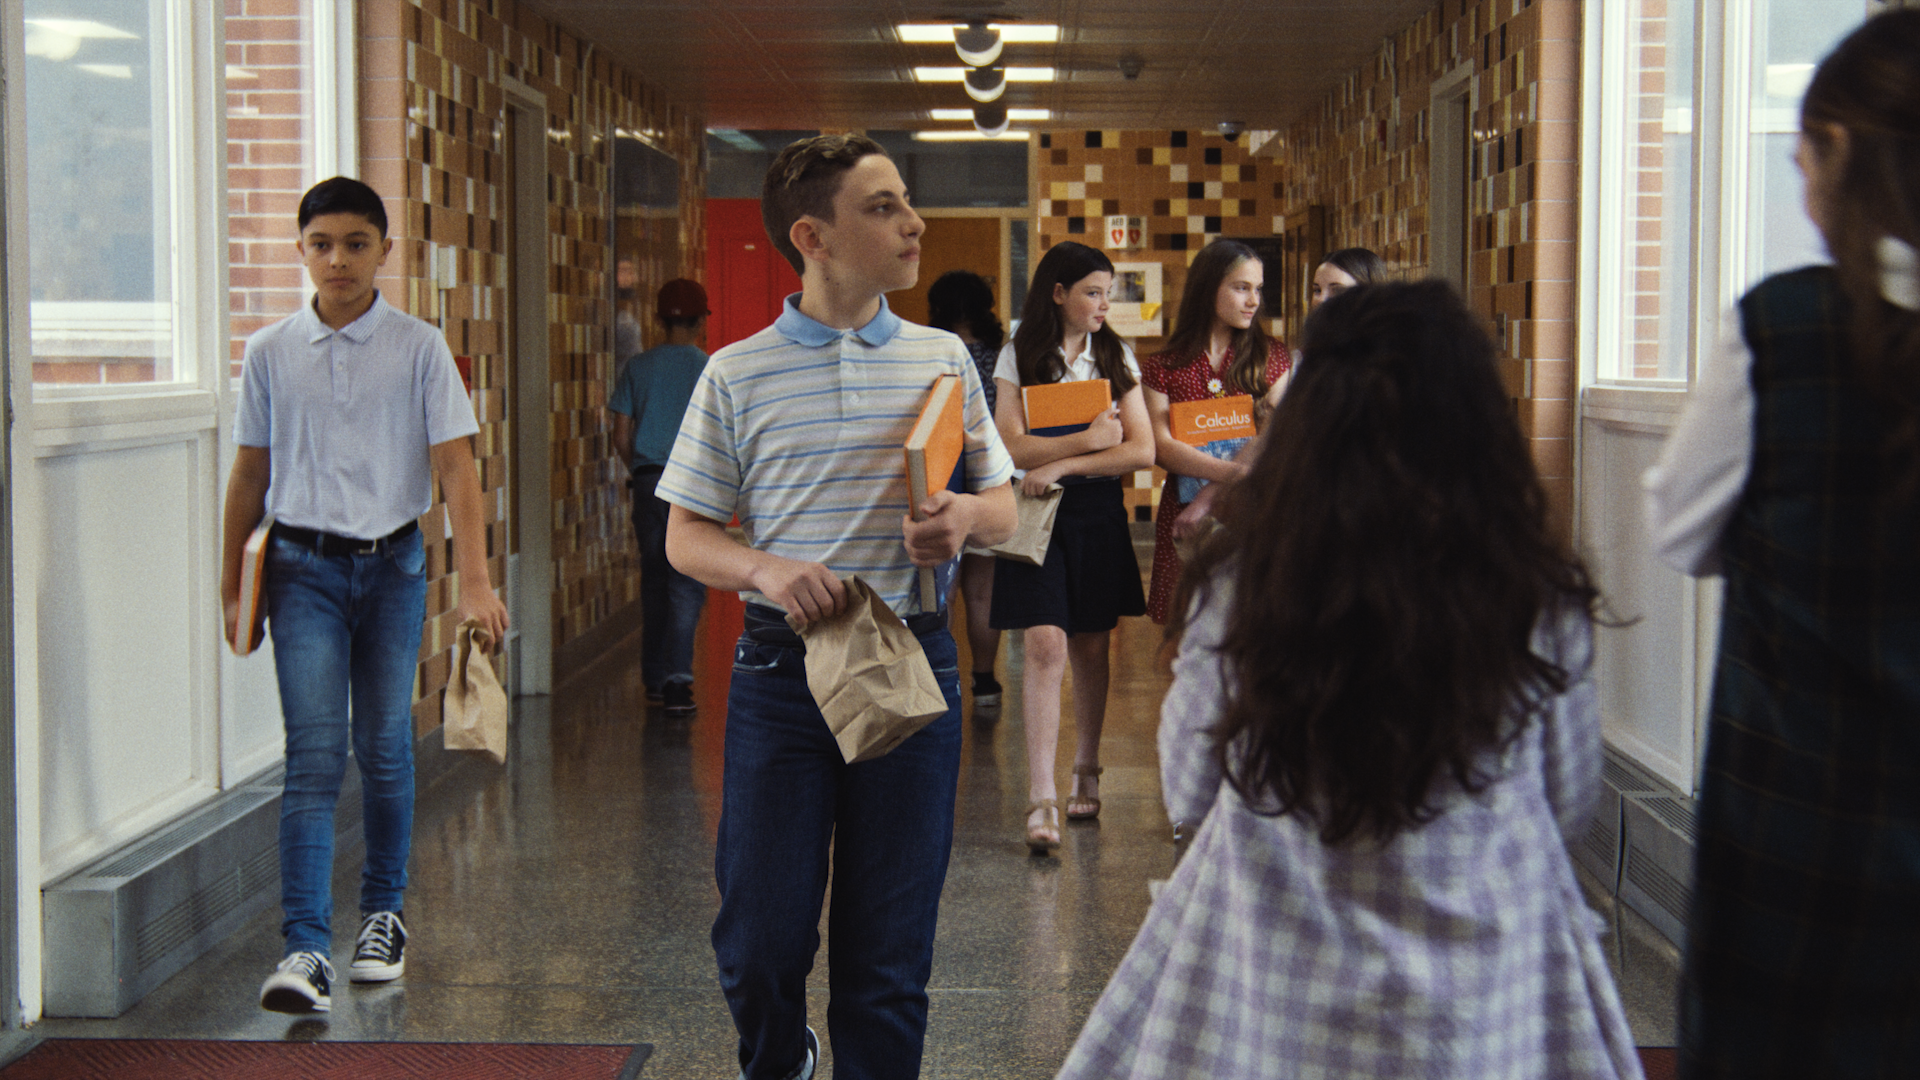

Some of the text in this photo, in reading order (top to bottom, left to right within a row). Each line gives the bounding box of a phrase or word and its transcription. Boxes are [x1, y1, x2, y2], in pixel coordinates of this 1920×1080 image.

[1111, 218, 1123, 226] AED
[1128, 218, 1140, 226] AED
[1195, 410, 1251, 429] Calculus
